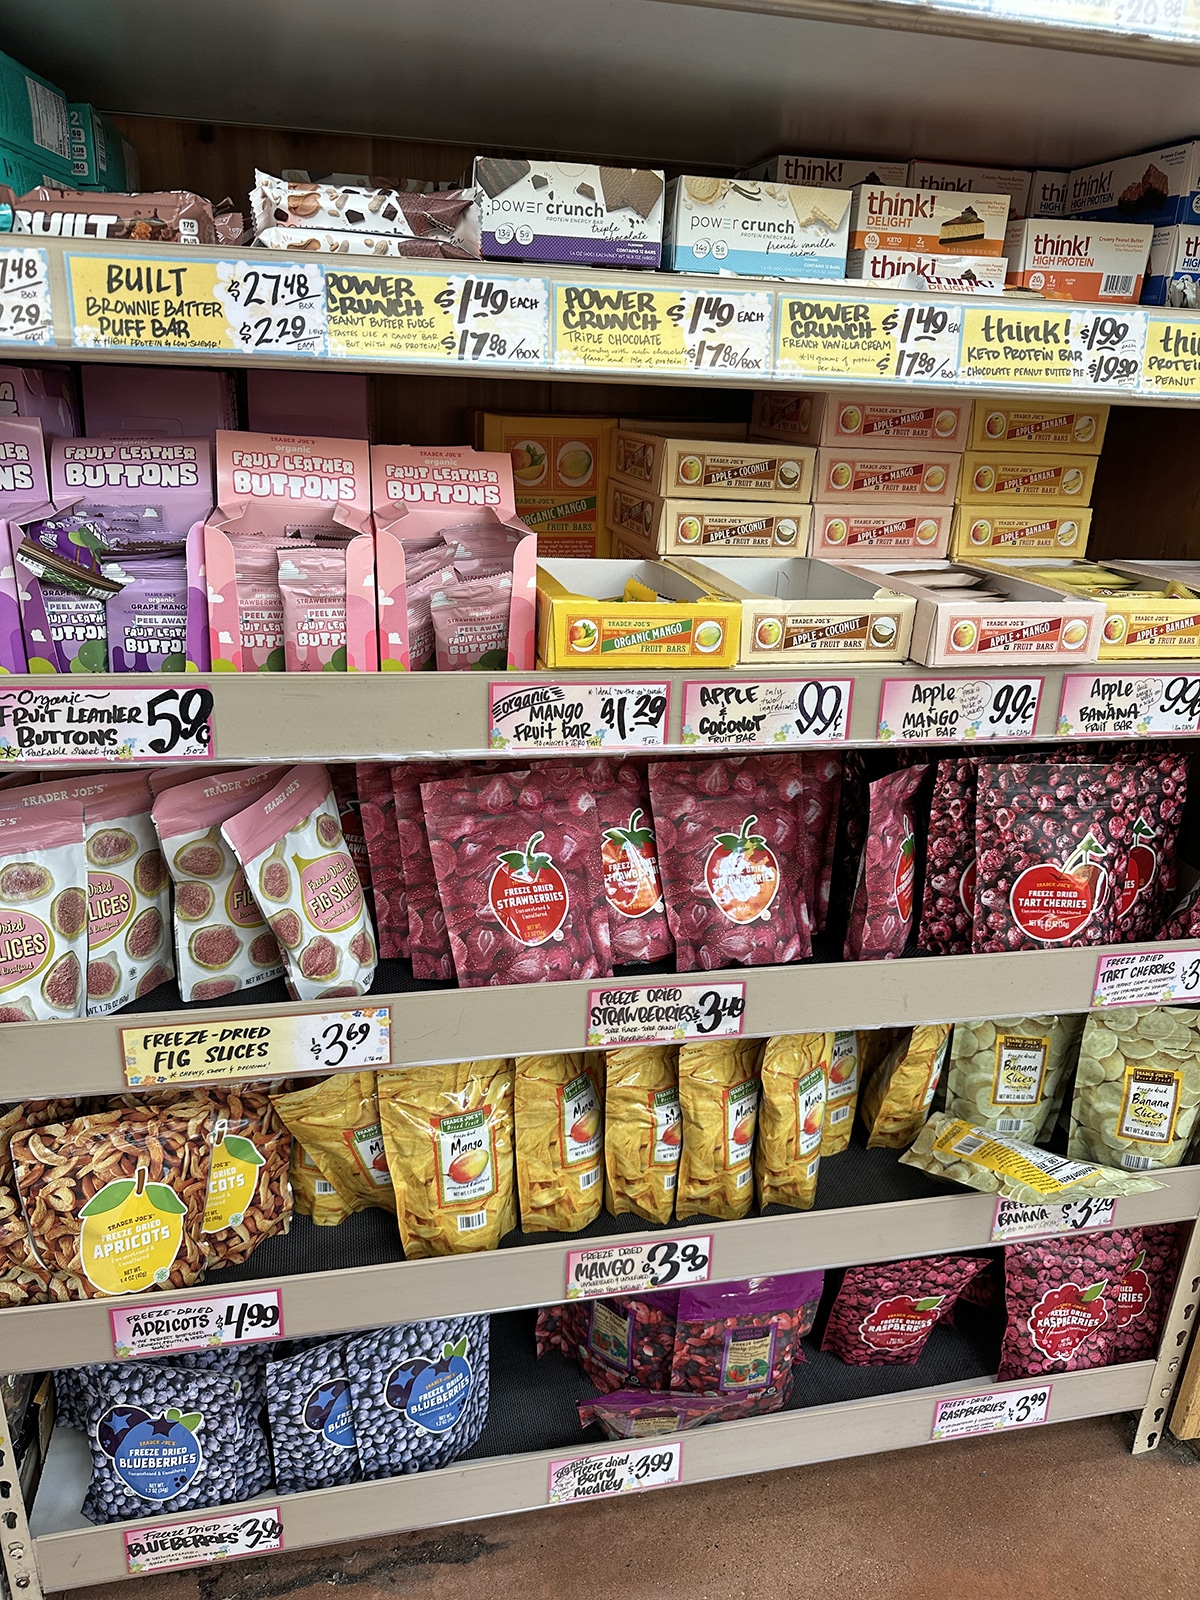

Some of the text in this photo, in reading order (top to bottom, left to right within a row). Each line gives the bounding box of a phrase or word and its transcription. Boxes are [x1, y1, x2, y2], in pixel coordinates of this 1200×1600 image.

[785, 159, 844, 182] think!
[1071, 174, 1113, 197] think!
[546, 201, 604, 218] crunch
[867, 192, 935, 218] think!
[1071, 194, 1114, 208] HIGH PROTEIN
[592, 224, 619, 234] triple
[741, 218, 794, 234] crunch
[867, 216, 912, 228] DELIGHT
[604, 232, 648, 241] chocolate
[766, 241, 799, 250] french
[1034, 234, 1092, 257] think!
[1033, 256, 1094, 266] HIGH PROTEIN
[108, 266, 187, 295] BUILT
[325, 273, 415, 297] POWER
[87, 298, 222, 317] BROWNIE BATTER
[299, 301, 314, 309] BOX
[326, 298, 424, 316] CRUNCH
[511, 298, 538, 310] EACH
[565, 286, 655, 312] POWER
[563, 310, 662, 330] CRUNCH
[738, 311, 764, 322] EACH
[790, 302, 868, 321] POWER
[100, 317, 190, 338] PUFF BAR
[327, 317, 435, 329] PEANUT BUTTER FUDGE
[791, 320, 877, 339] CRUNCH
[981, 315, 1071, 346] think!
[297, 341, 315, 350] EACH
[563, 330, 661, 345] TRIPLE CHOCOLATE
[783, 339, 891, 350] FRENCH VANILLA CREAM
[967, 347, 1083, 362] KETO PROTEIN BAR
[966, 368, 1071, 377] CHOCOLATE PEANUT BUTTER
[65, 446, 195, 460] FRUIT LEATHER
[233, 451, 355, 475] FRUIT LEATHER
[65, 463, 198, 487] BUTTONS
[385, 465, 499, 483] FRUIT LEATHER
[233, 471, 356, 500] BUTTONS
[386, 481, 501, 504] BUTTONS
[614, 623, 682, 649] ORGANIC MANGO
[793, 618, 860, 646] APPLE COCONUT
[990, 622, 1050, 649] APPLE MANGO
[1136, 617, 1195, 643] APPLE BANANA
[640, 645, 686, 653] FRUIT BARS
[843, 640, 862, 648] BARS
[1013, 642, 1053, 651] FRUIT BARS
[1160, 636, 1195, 645] FRUIT BARS
[701, 686, 759, 706] APPLE
[912, 684, 955, 705] Apple
[1091, 678, 1133, 698] Apple
[0, 704, 143, 726] FRUIT LEATHER
[529, 702, 584, 723] MANGO
[903, 710, 959, 728] MANGO
[1079, 707, 1140, 721] BANANA
[700, 714, 766, 733] COCONUT
[1085, 720, 1132, 733] FRUIT BAR
[16, 726, 118, 748] BUTTONS
[708, 732, 756, 743] FRUIT BAR
[902, 727, 956, 739] FRUIT BAR
[23, 783, 104, 808] TRADER JOE'S
[310, 871, 359, 918] FIG SLICES
[504, 884, 554, 897] FREEZE DRIED
[497, 891, 564, 909] STRAWBERRIES
[1019, 899, 1086, 909] TART CHERRIES
[1107, 954, 1164, 967] FREEZE DRIED
[1100, 962, 1175, 983] TART CHERRIES
[600, 989, 682, 1005] FREEZE DRIED
[592, 1004, 694, 1027] STRAWBERRIES
[143, 1026, 271, 1051] FREEZE-DRIED
[154, 1042, 269, 1073] FIG SLICES
[1004, 1061, 1038, 1073] Banana
[1006, 1072, 1033, 1083] Slices
[1132, 1093, 1169, 1109] Banana
[1134, 1106, 1164, 1121] Slices
[451, 1139, 482, 1155] Mango
[998, 1210, 1048, 1226] BANANA
[102, 1219, 162, 1242] FREEZE DRIED
[93, 1225, 170, 1259] APRICOTS
[582, 1247, 643, 1262] FREEZE DRIED
[574, 1259, 635, 1281] MANGO
[1046, 1309, 1092, 1318] FREEZE DRIED
[131, 1314, 209, 1337] APRICOTS
[1038, 1317, 1099, 1330] RASPBERRIES
[410, 1376, 470, 1416] BLUEBERRIES
[419, 1373, 464, 1403] FREEZE DRIED
[940, 1401, 1007, 1422] RASPBERRIES
[119, 1452, 196, 1469] BLUEBERRIES
[129, 1446, 187, 1458] FREEZE DRIED
[127, 1531, 238, 1559] BLUEBERRIES
